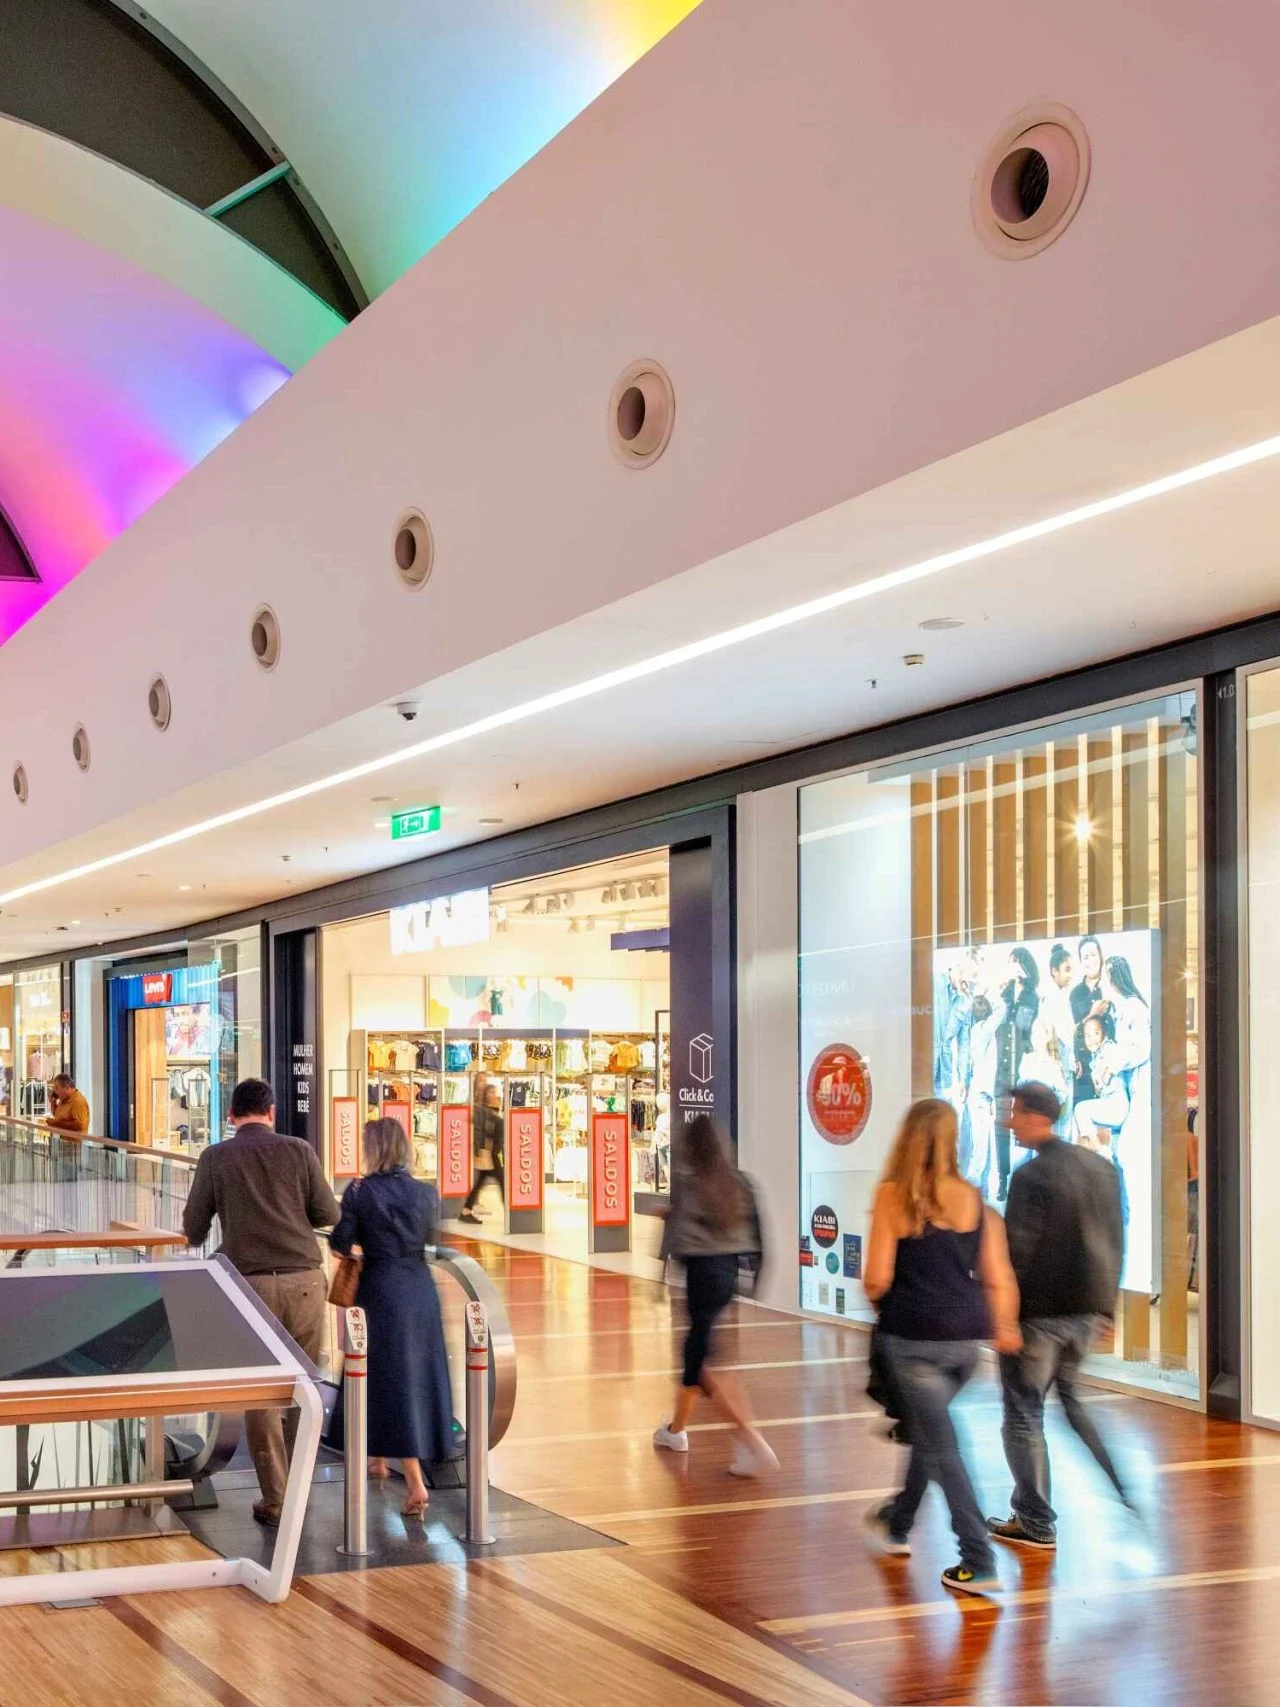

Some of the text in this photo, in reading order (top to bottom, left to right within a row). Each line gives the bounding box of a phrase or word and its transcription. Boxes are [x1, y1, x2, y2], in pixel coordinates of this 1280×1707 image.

[293, 1044, 314, 1057] MULHER
[293, 1063, 314, 1075] HOMEM
[297, 1081, 310, 1094] KIDS
[340, 1110, 352, 1166] SALDOS
[450, 1119, 462, 1184] SALDOS
[519, 1123, 532, 1194] SALDOS
[604, 1130, 618, 1208] SALDOS
